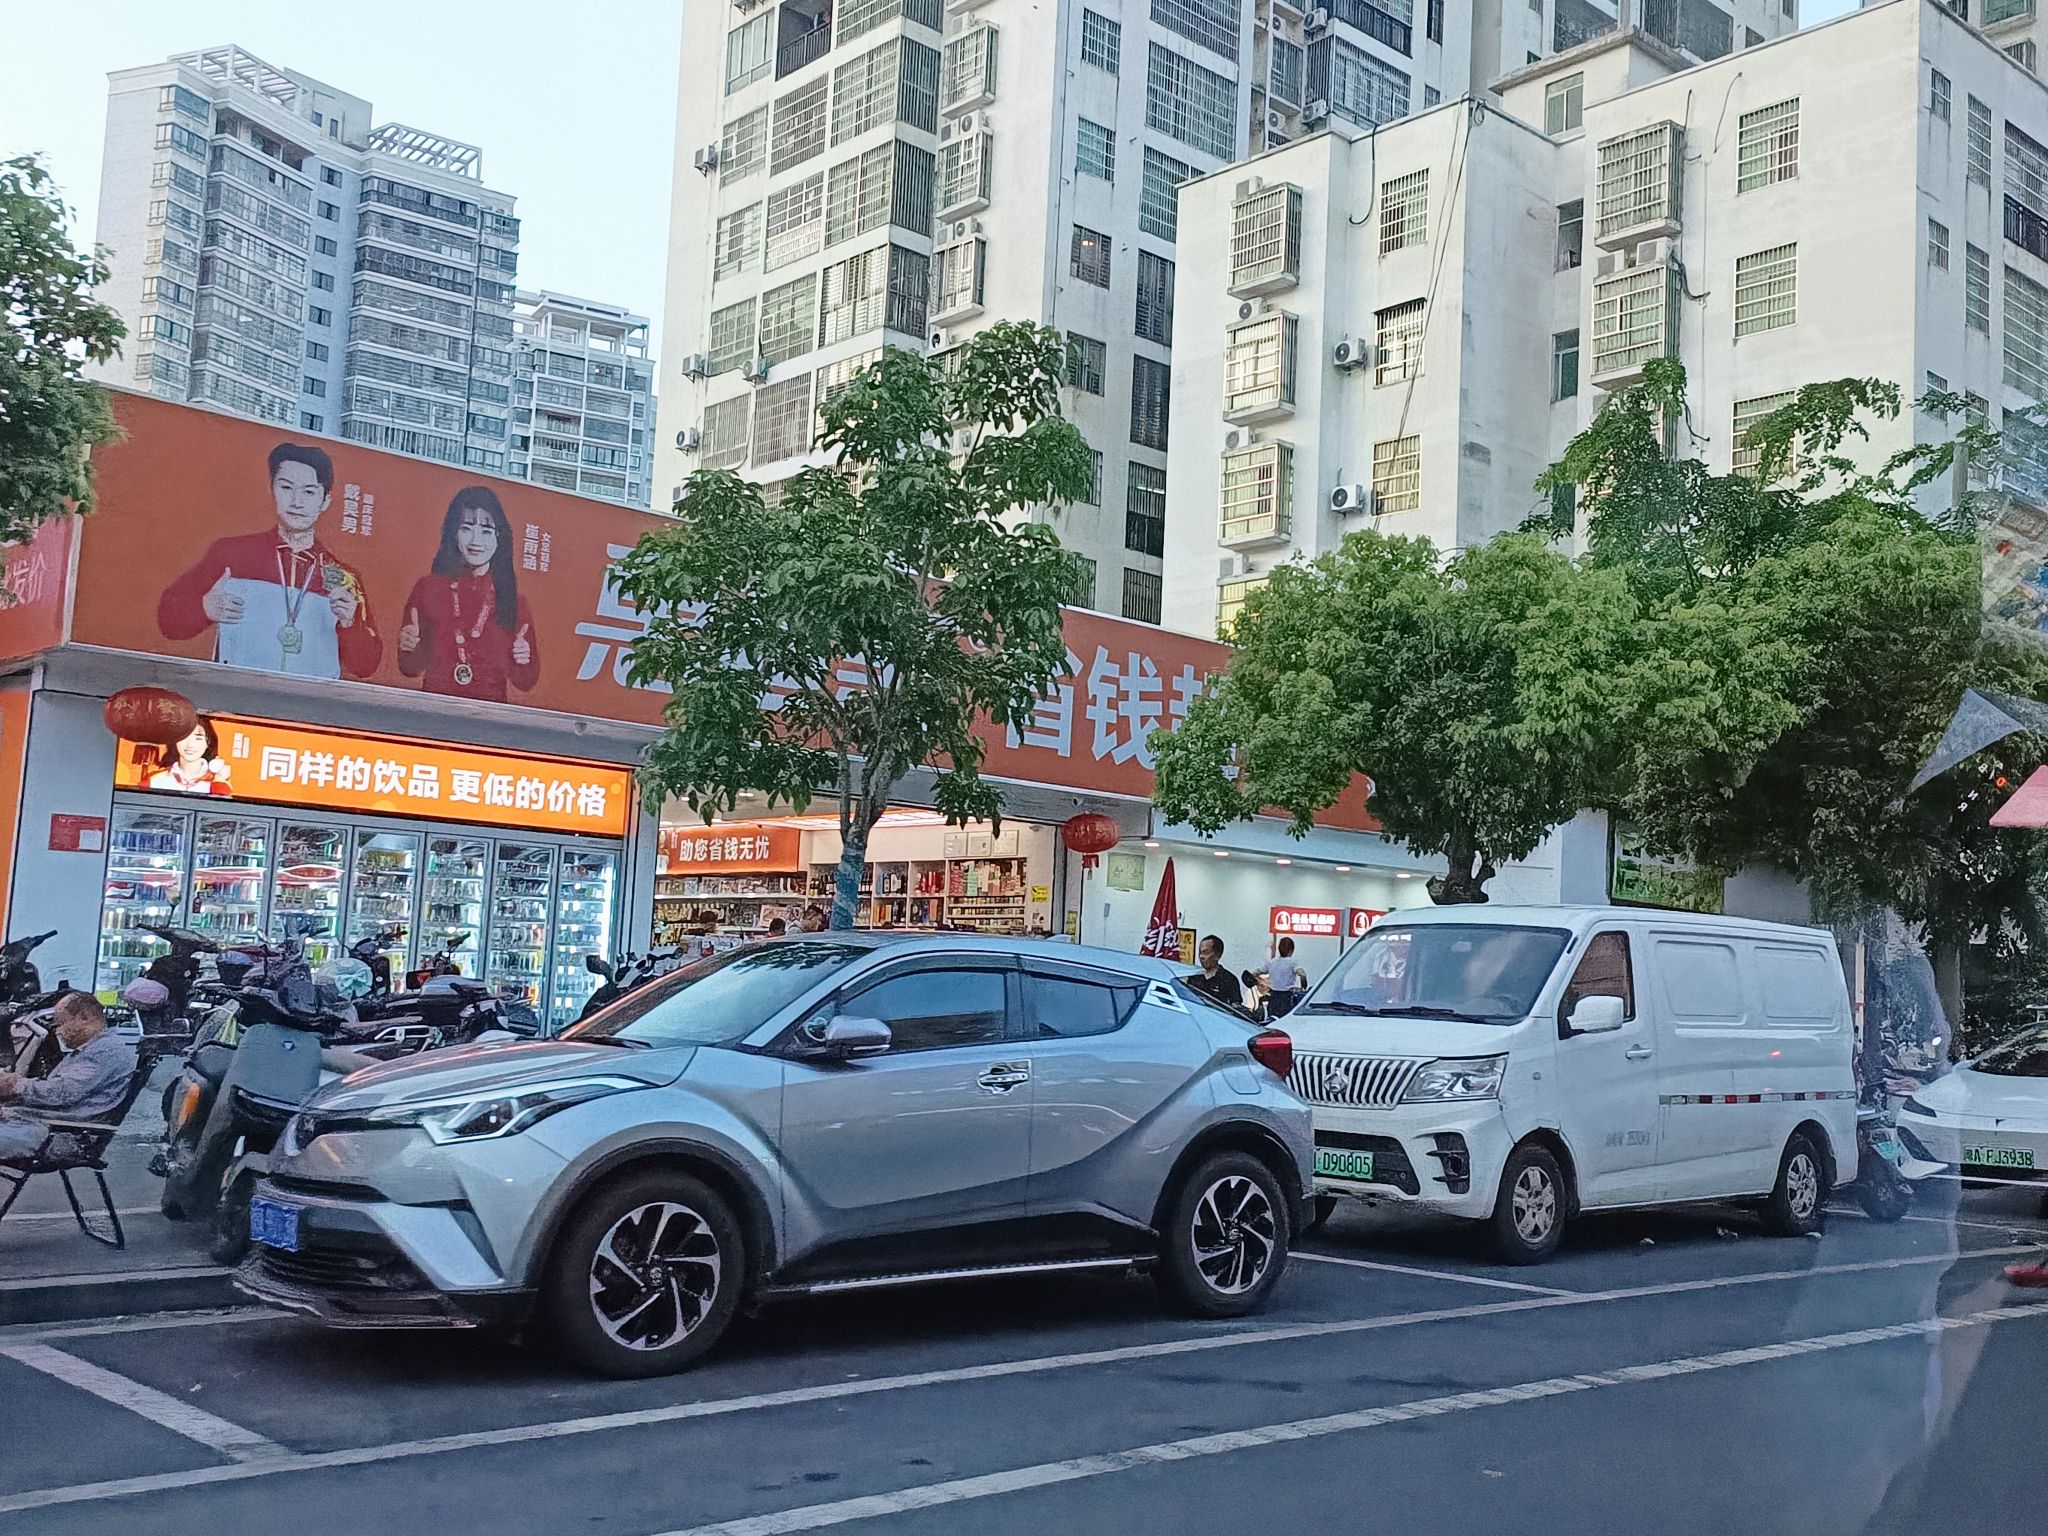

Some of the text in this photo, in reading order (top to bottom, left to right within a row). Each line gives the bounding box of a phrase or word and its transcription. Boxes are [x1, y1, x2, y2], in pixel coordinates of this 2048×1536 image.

[259, 745, 440, 800] 同样的饮品
[449, 767, 608, 818] 更低的价格
[679, 835, 770, 862] 助您省钱无忧
[1322, 1151, 1371, 1175] D90805
